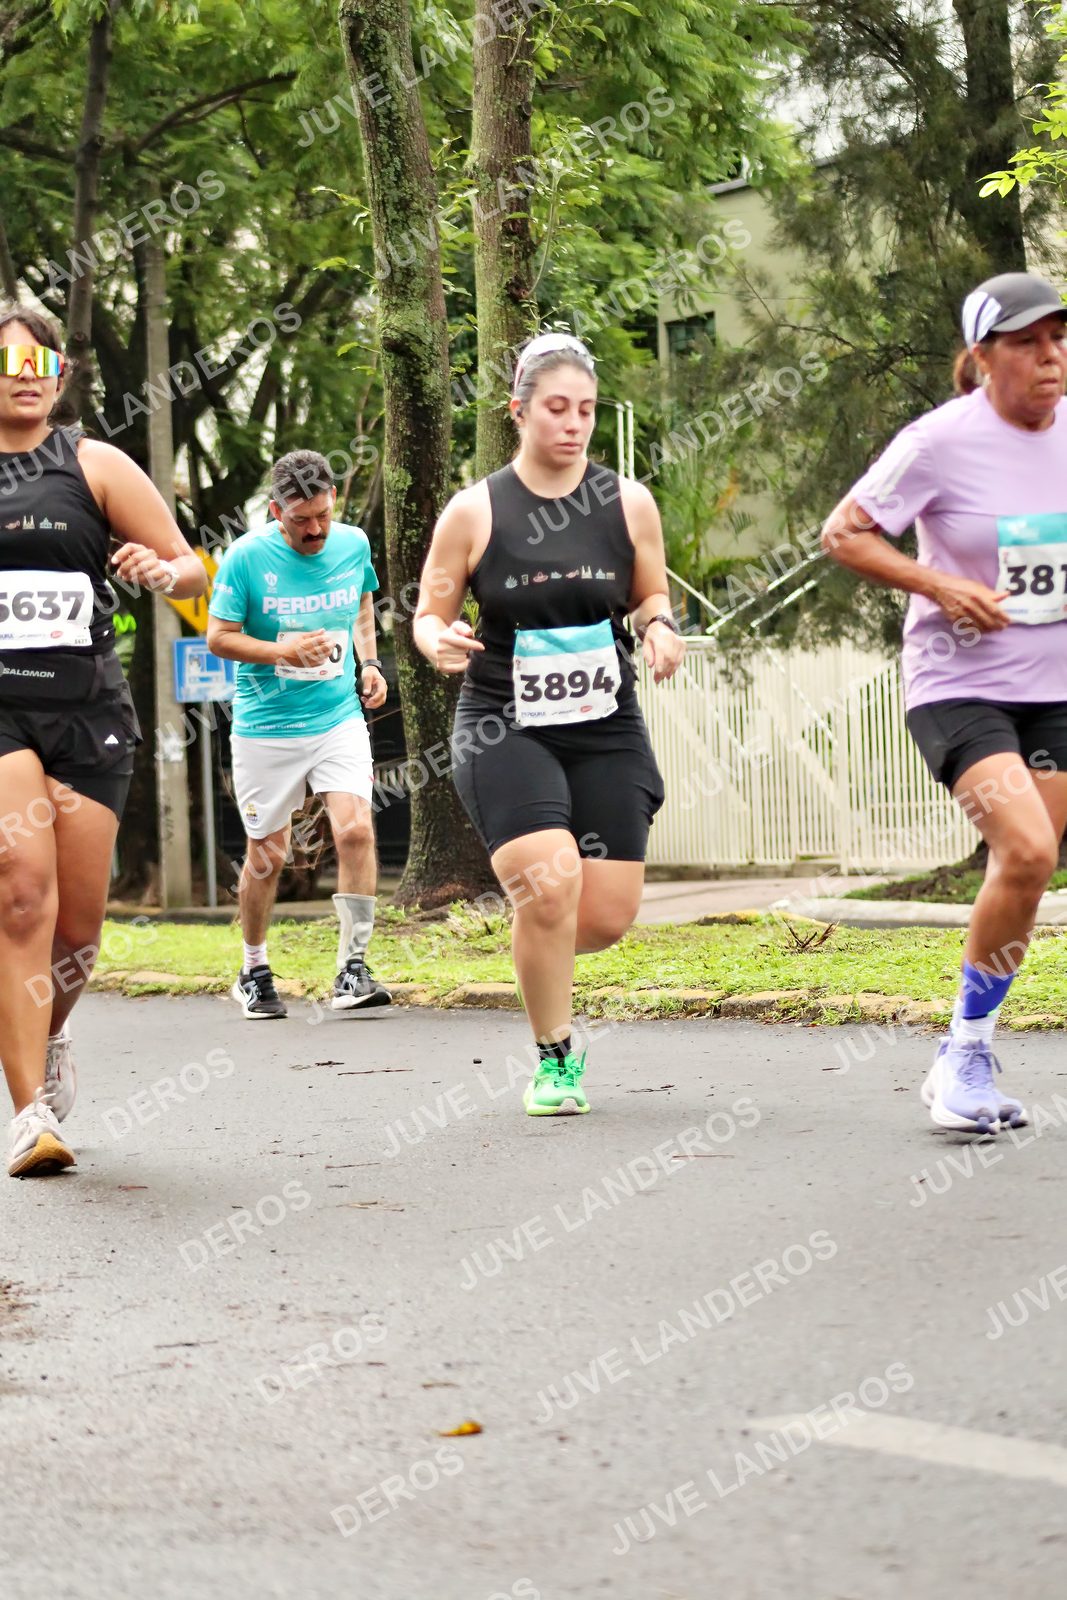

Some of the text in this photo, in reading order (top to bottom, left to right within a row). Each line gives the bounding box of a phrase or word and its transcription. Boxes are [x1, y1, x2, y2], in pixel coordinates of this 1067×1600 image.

[262, 585, 358, 615] PERDURA
[2, 667, 55, 678] SALOMON
[520, 667, 615, 702] 3894
